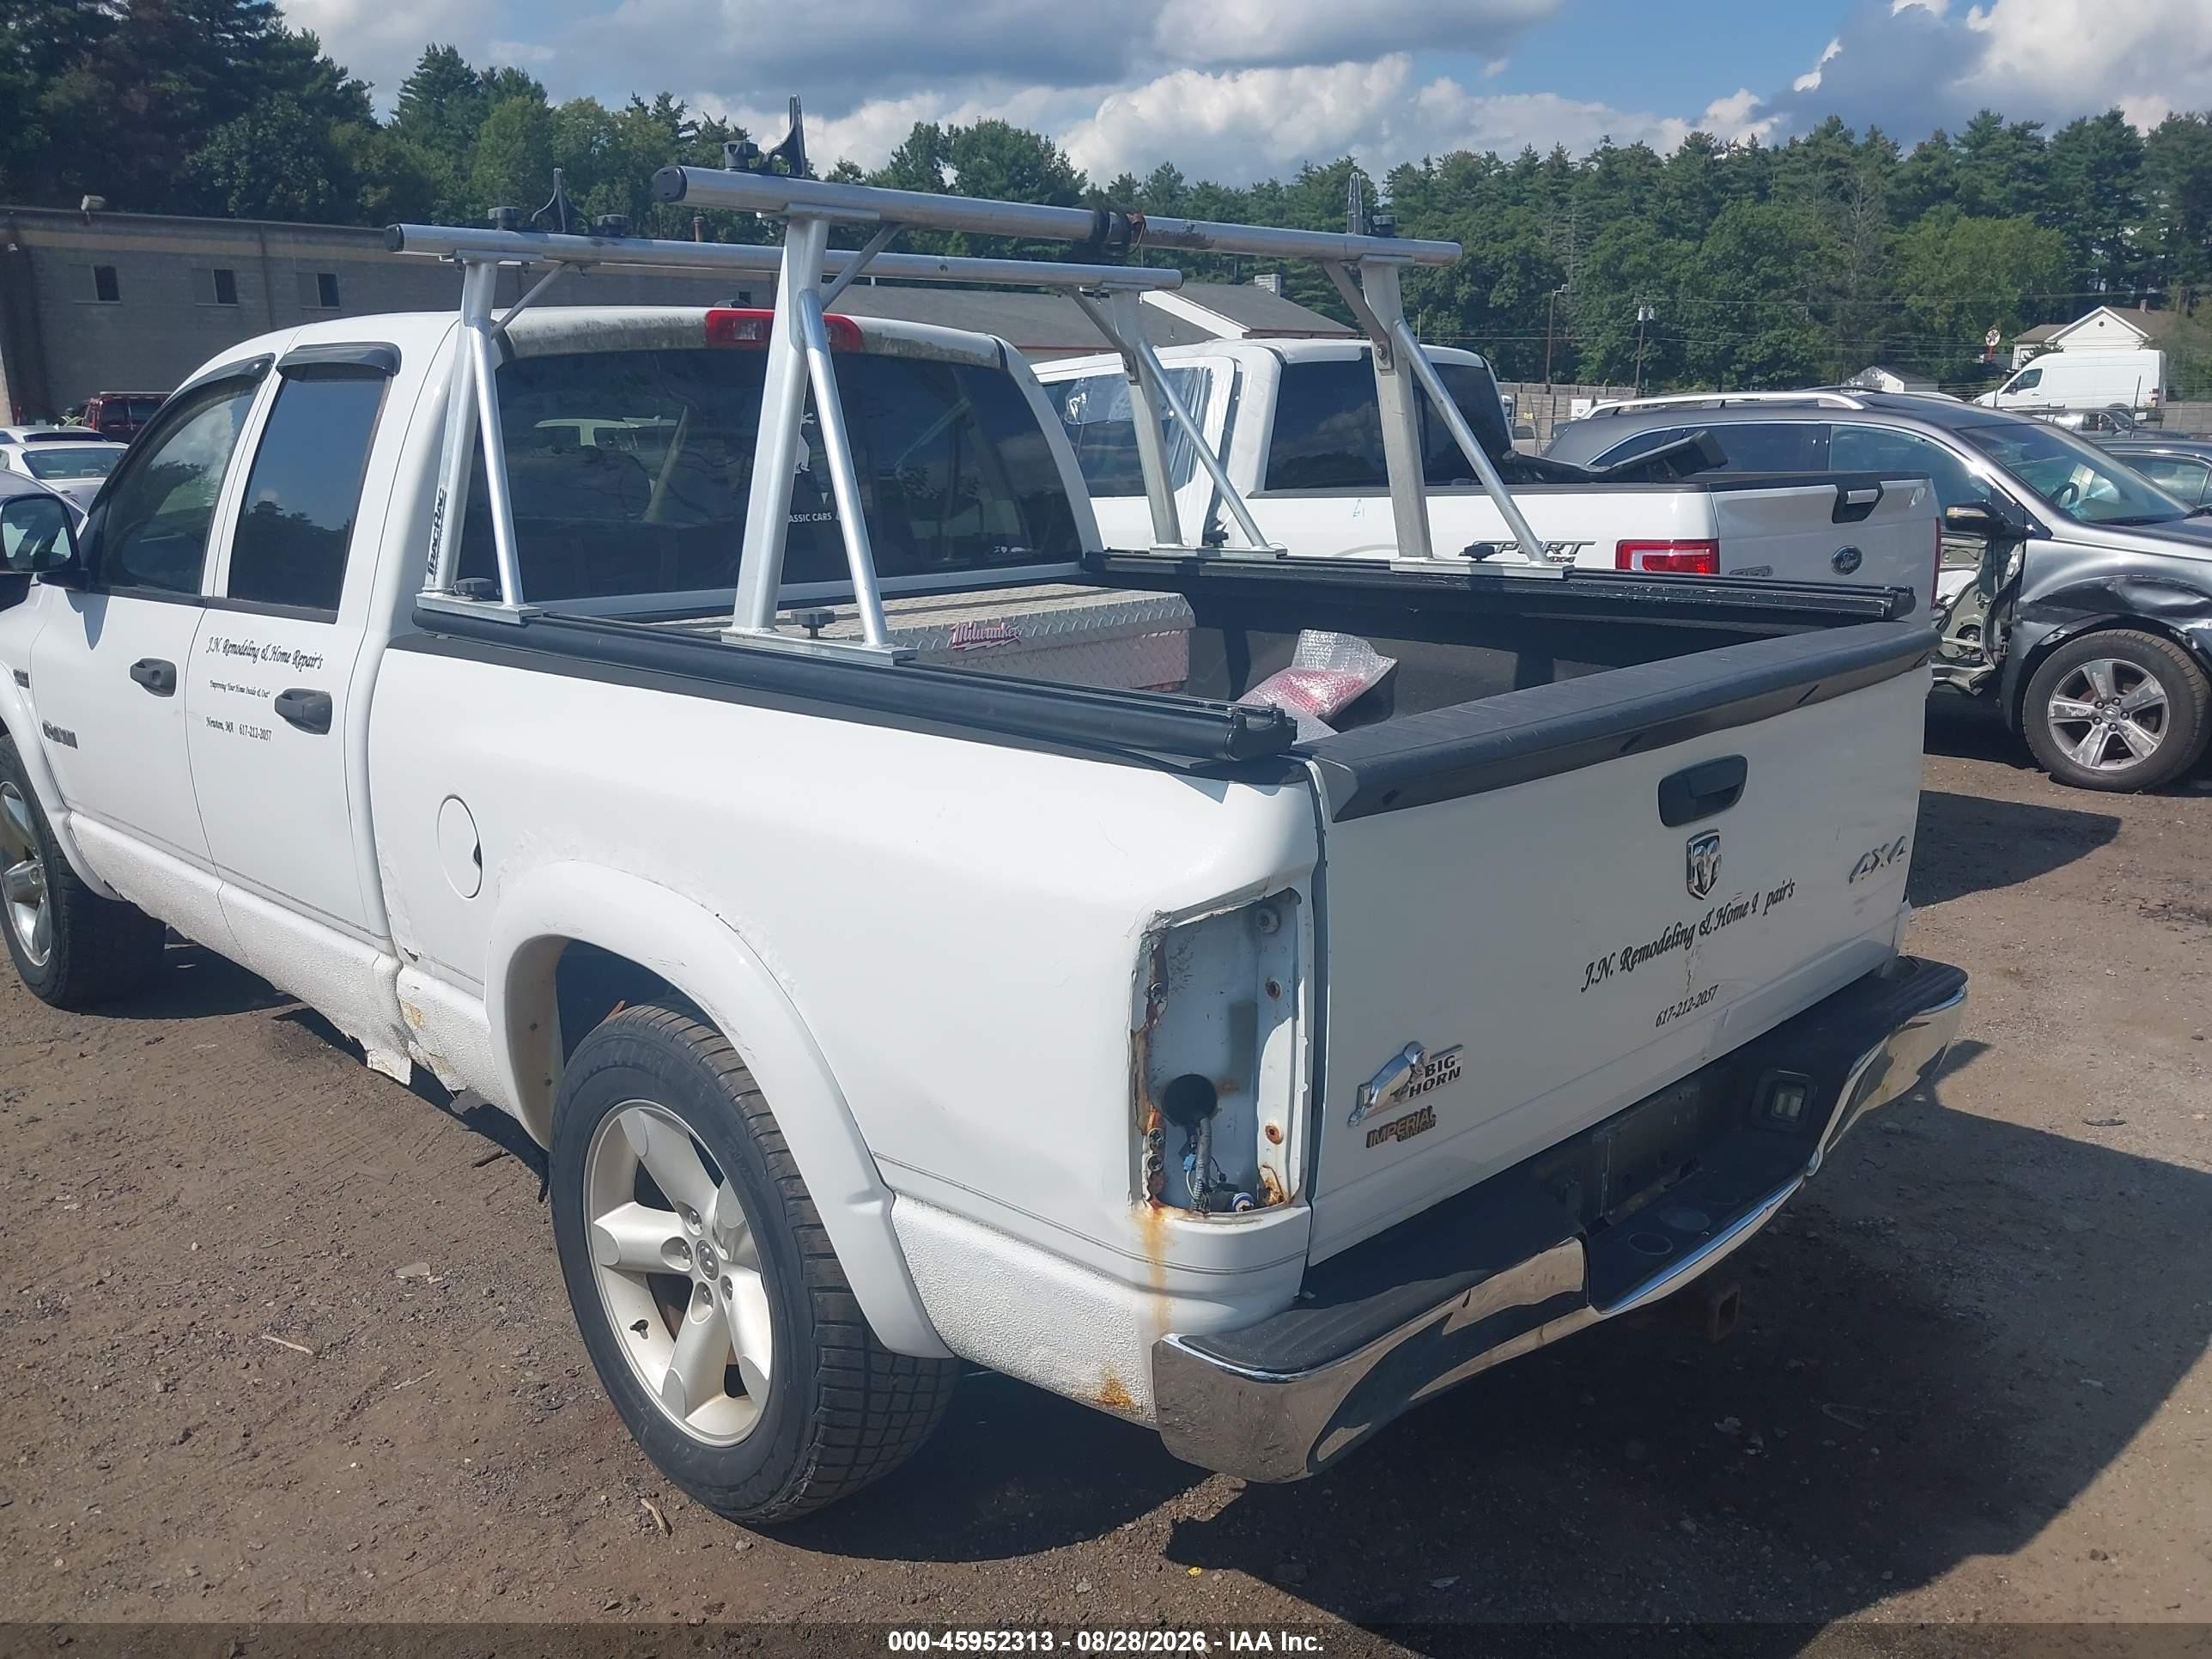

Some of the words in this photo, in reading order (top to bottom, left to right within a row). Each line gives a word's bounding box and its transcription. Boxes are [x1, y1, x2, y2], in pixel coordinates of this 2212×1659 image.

[789, 514, 811, 523] ASSIC
[812, 513, 832, 522] CARS
[206, 636, 222, 653] J.N.
[222, 638, 260, 665] Remodeling
[260, 642, 272, 661] &
[269, 645, 292, 664] Home
[292, 649, 324, 673] Repair's
[239, 723, 272, 742] 617-212-2057
[1581, 951, 1616, 994] J.N.
[1620, 921, 1696, 973] Remodeling
[1698, 907, 1715, 937] &
[1714, 901, 1750, 932] Home
[1656, 984, 1719, 1028] 617-212-2057
[1409, 1066, 1462, 1098] HORN
[1425, 1054, 1455, 1079] BIG
[1366, 1104, 1437, 1148] IMPERIAL
